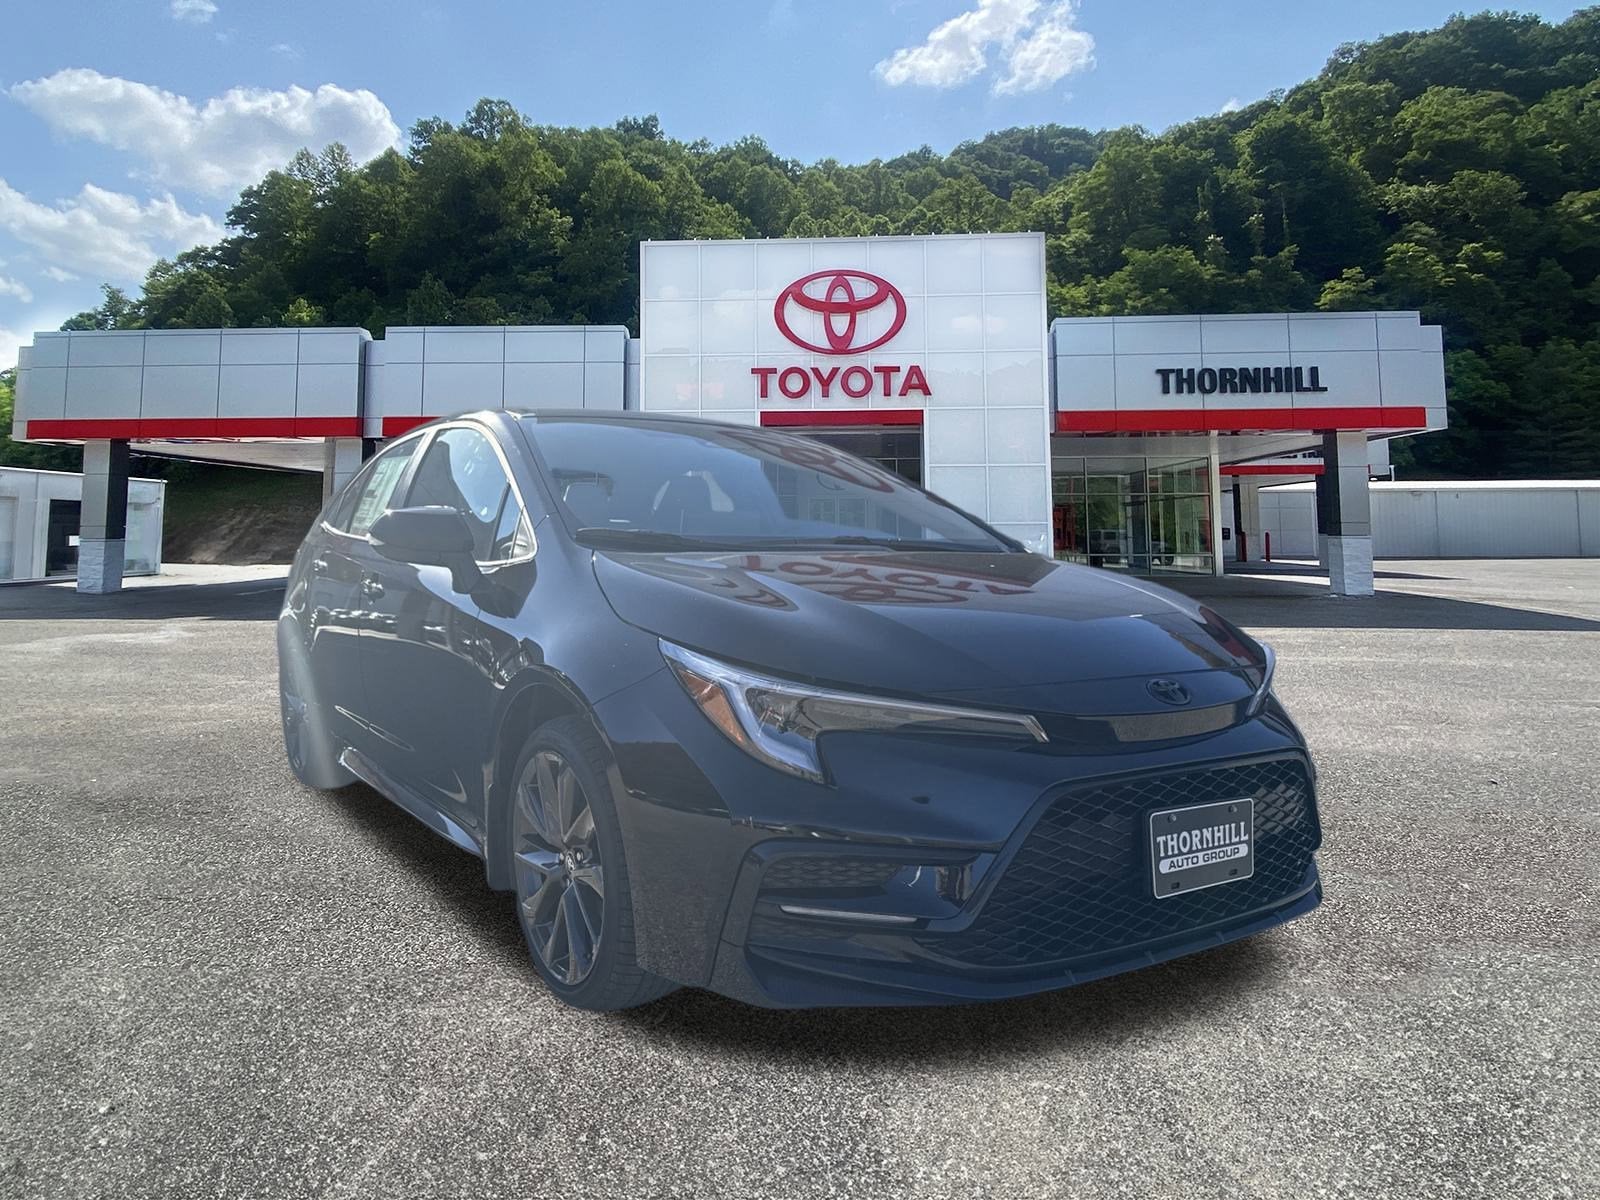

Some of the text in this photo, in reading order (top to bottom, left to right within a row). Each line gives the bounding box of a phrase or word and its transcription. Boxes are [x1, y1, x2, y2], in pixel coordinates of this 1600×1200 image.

[751, 365, 932, 399] TOYOTA
[1155, 366, 1328, 394] THORNHILL
[1156, 822, 1248, 857] THORNHILL
[1168, 846, 1240, 870] AUTO GROUP
